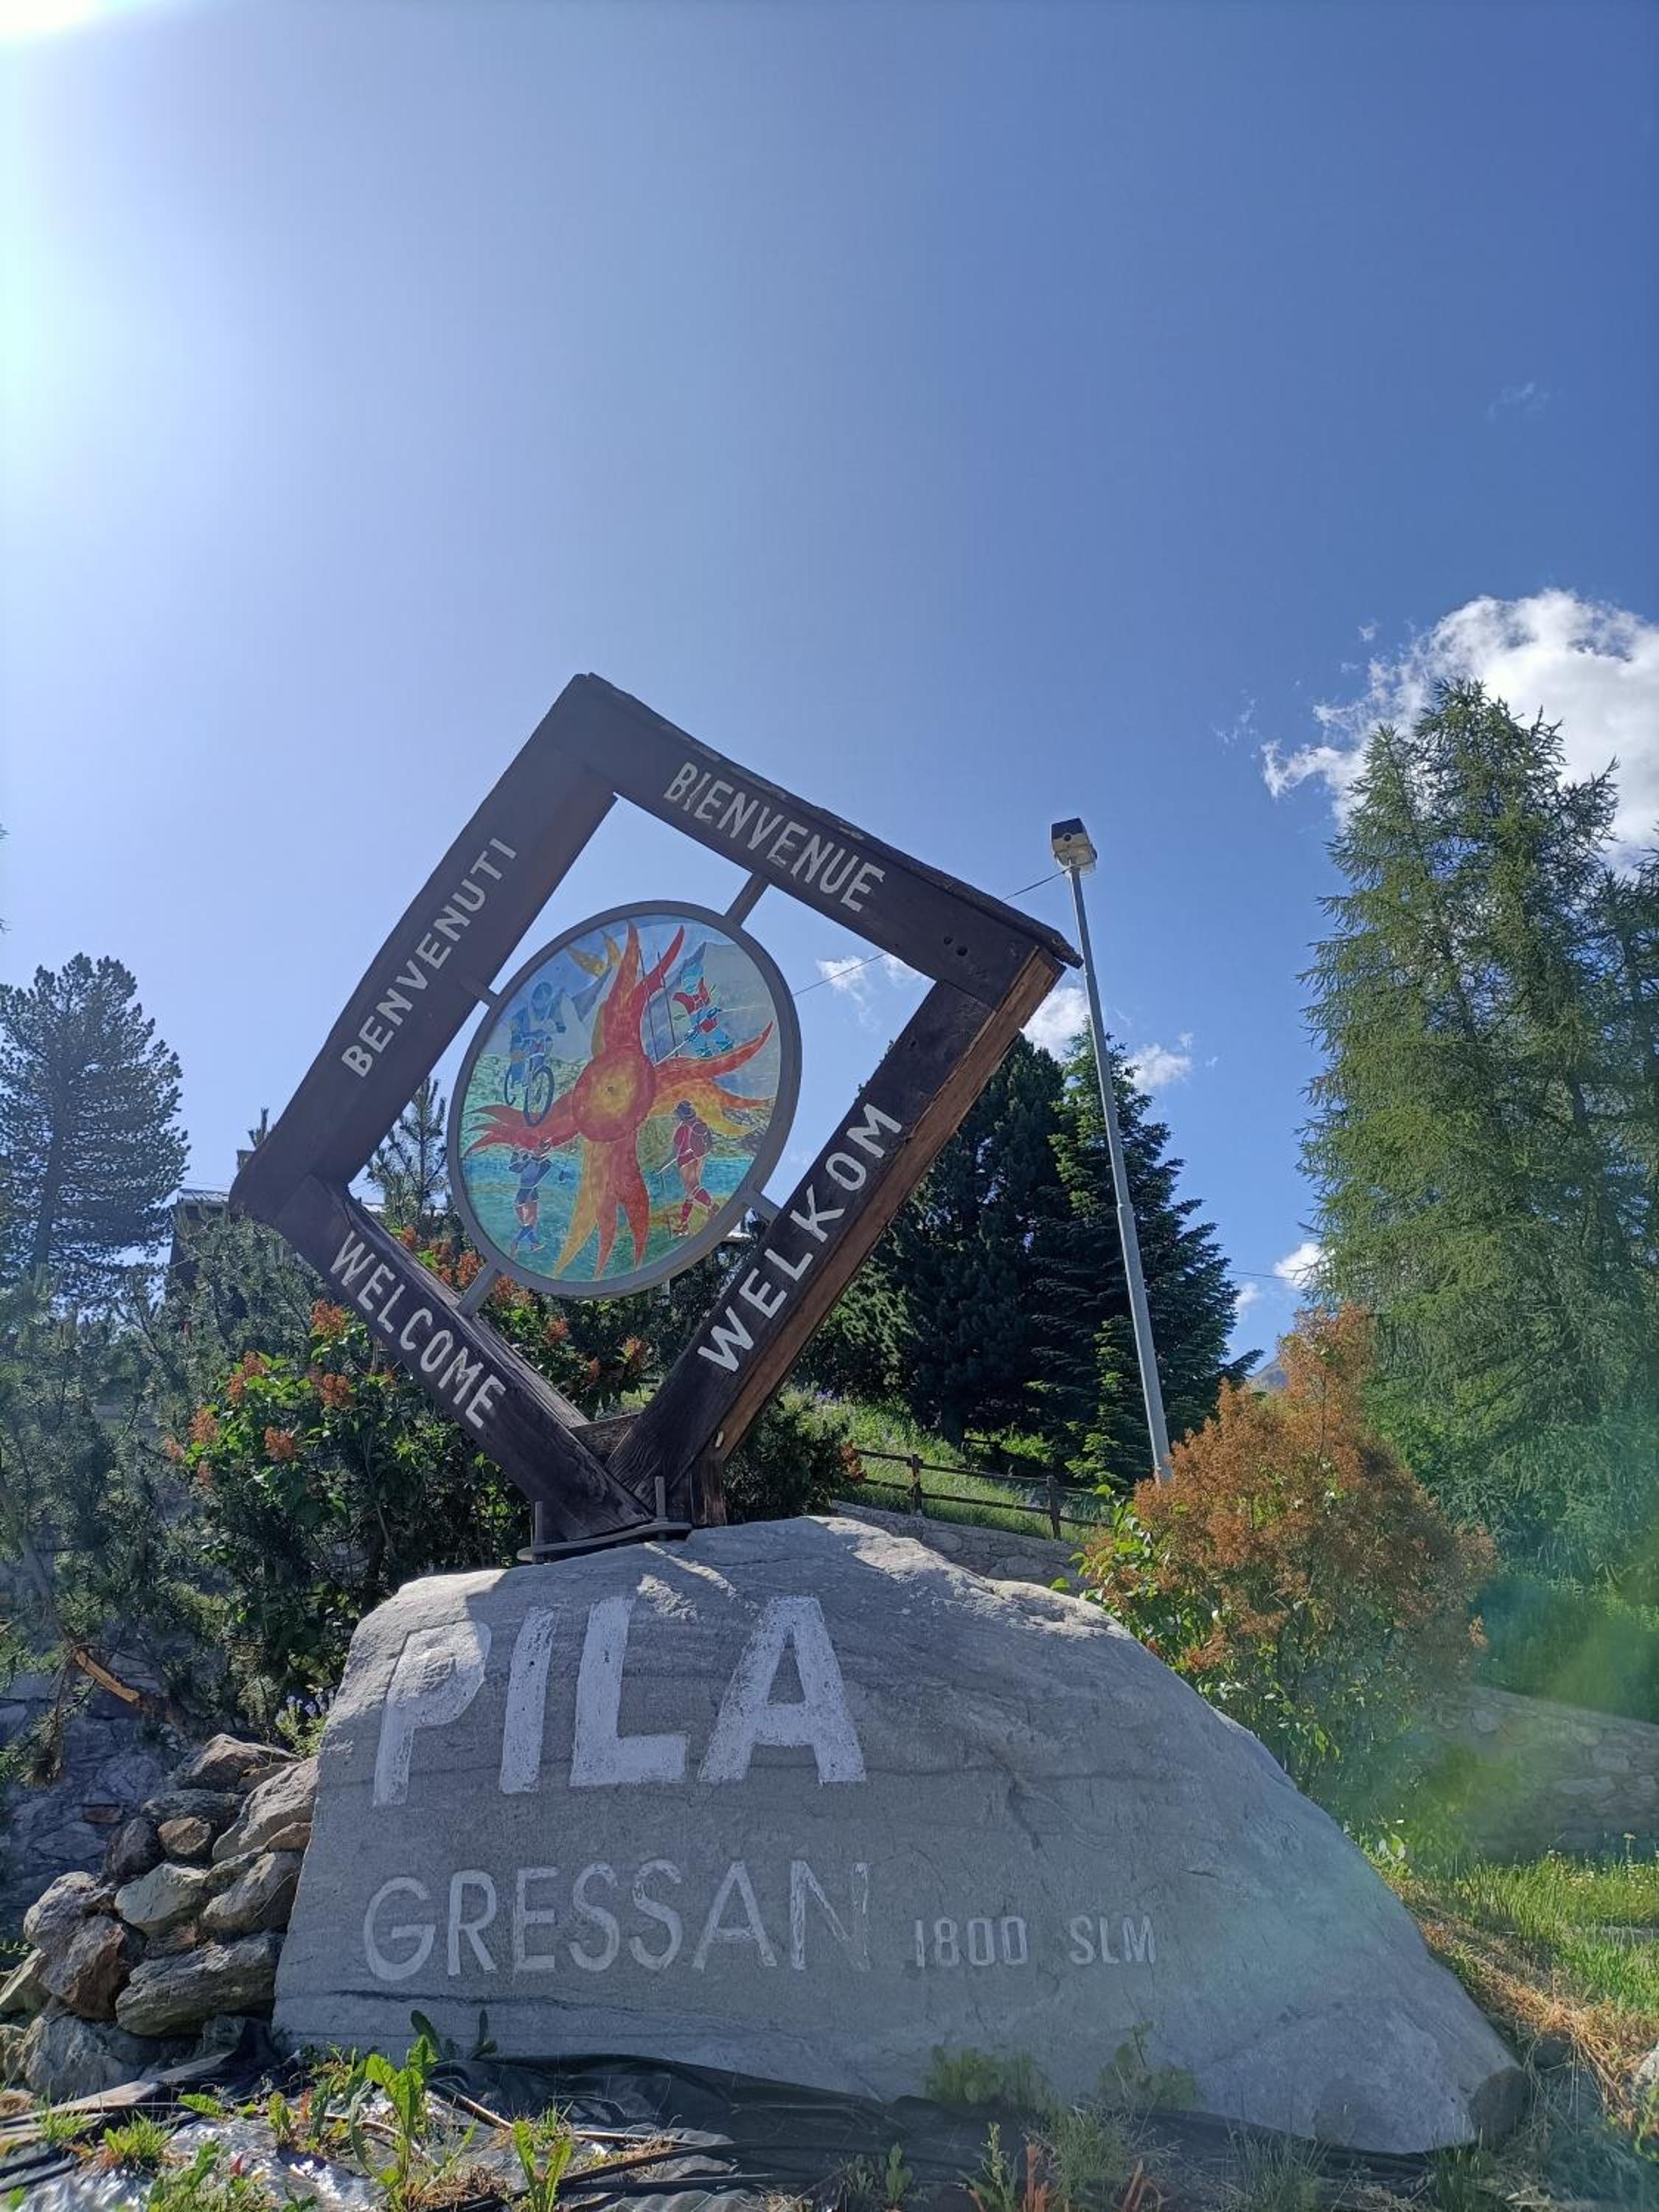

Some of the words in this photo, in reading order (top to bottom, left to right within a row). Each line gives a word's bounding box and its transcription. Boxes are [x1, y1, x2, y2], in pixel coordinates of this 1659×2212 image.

[664, 762, 885, 913] BIENVENUE
[341, 837, 516, 1077] BENVENUTI
[330, 1231, 507, 1429] WELCOME
[698, 1102, 905, 1373] WELKOM
[374, 1596, 866, 1806] PILA
[364, 1860, 872, 1981] GRESSAN
[915, 1916, 1028, 1968] 1800
[1071, 1916, 1157, 1966] SLM
